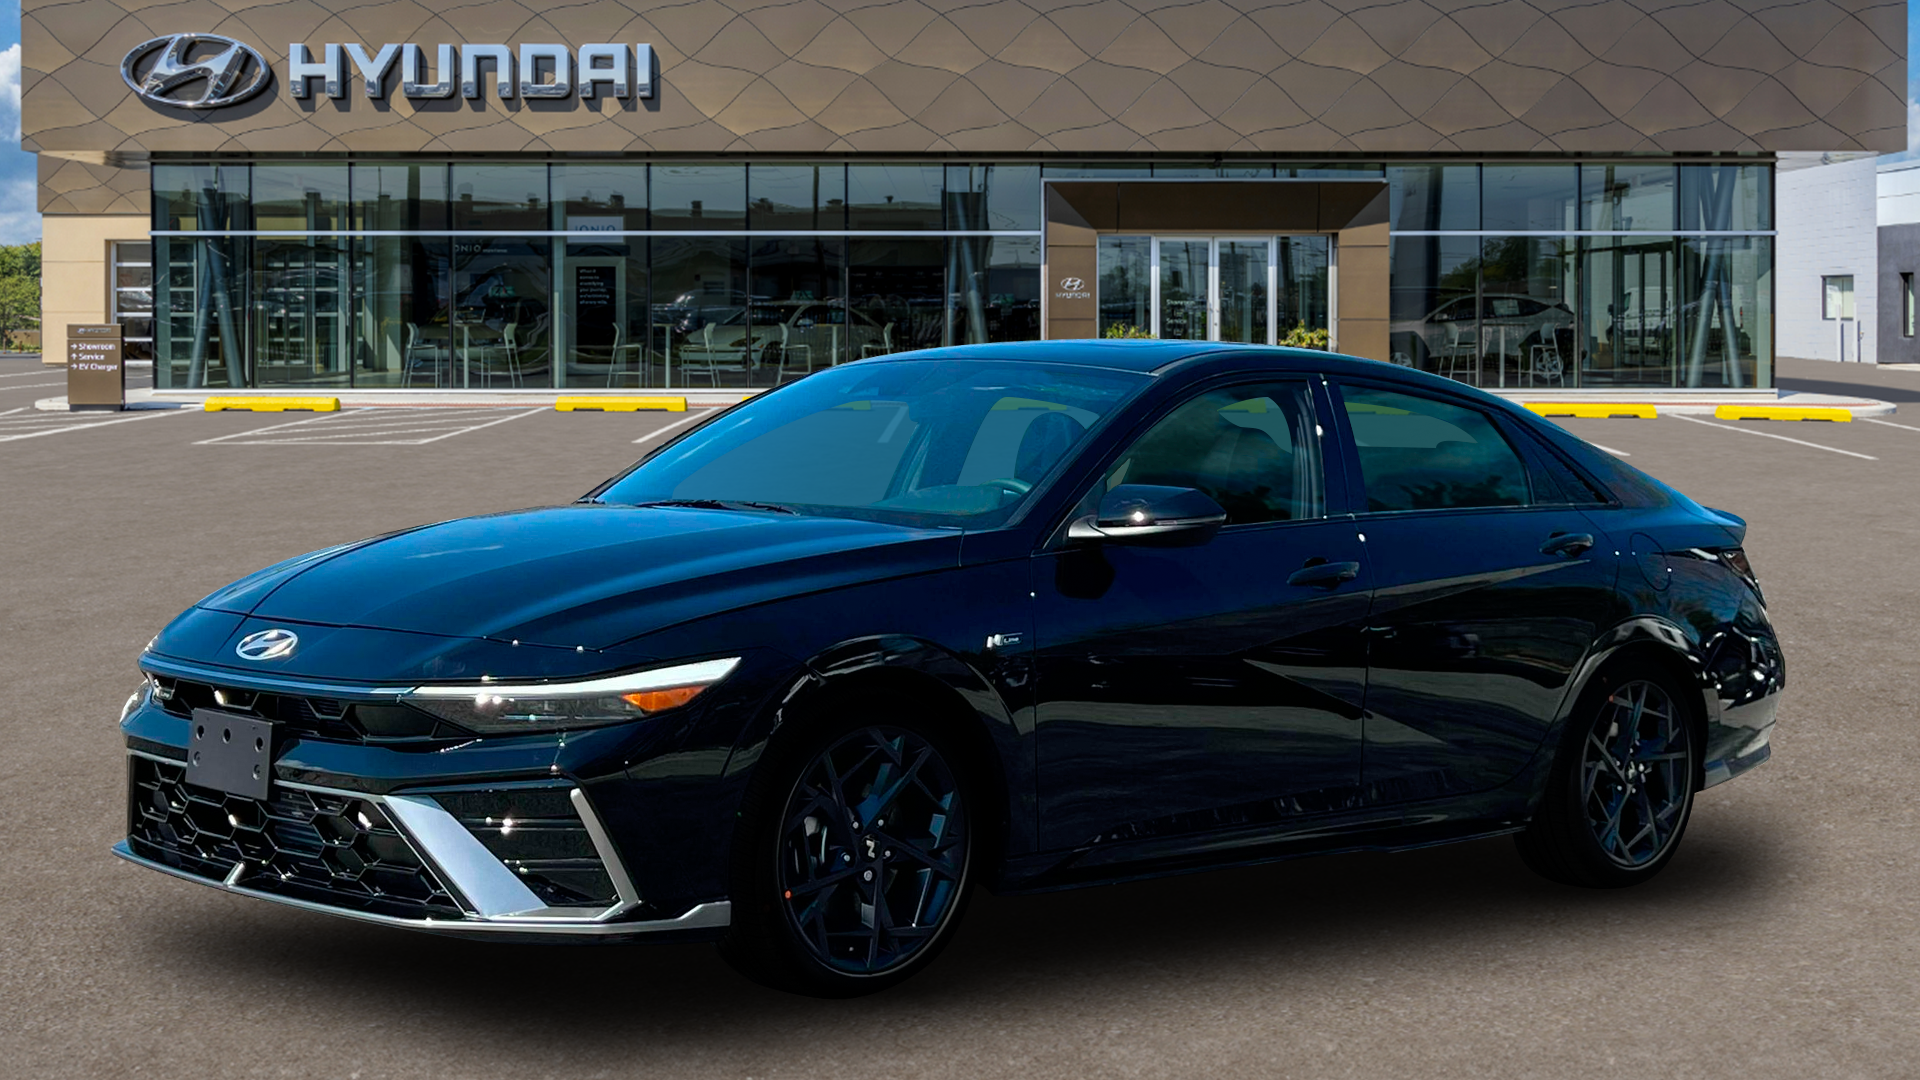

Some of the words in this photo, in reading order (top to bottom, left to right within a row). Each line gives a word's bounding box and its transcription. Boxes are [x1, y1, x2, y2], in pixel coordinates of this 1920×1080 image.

[289, 43, 656, 99] HYUNDAI
[78, 343, 116, 351] Showroom
[90, 363, 118, 372] Charger
